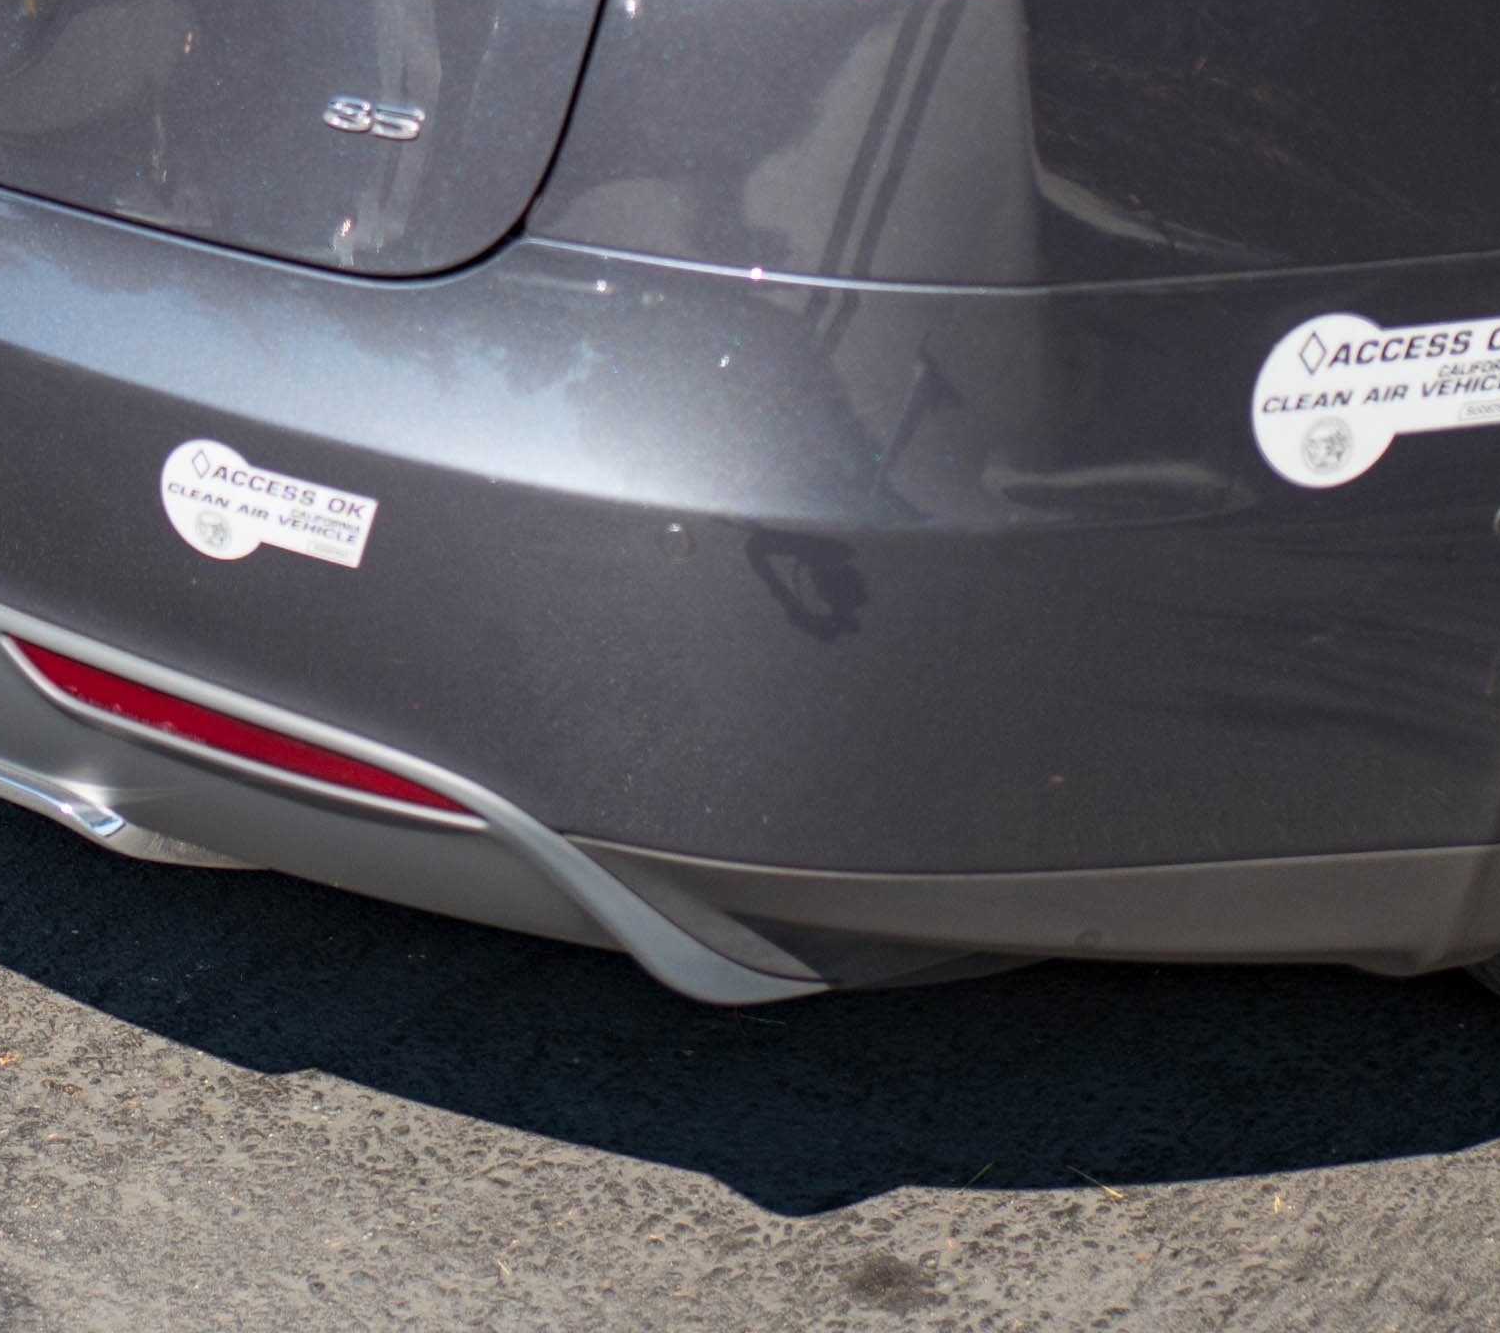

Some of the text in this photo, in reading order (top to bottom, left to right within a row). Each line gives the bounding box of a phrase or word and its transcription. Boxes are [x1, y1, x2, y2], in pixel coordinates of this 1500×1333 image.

[1328, 330, 1472, 368] ACCESS
[1261, 391, 1352, 414] CLEAN
[1363, 384, 1408, 405] AIR
[167, 482, 357, 544] CLEAN AIR VEHICLE
[212, 465, 367, 519] ACCESS OK
